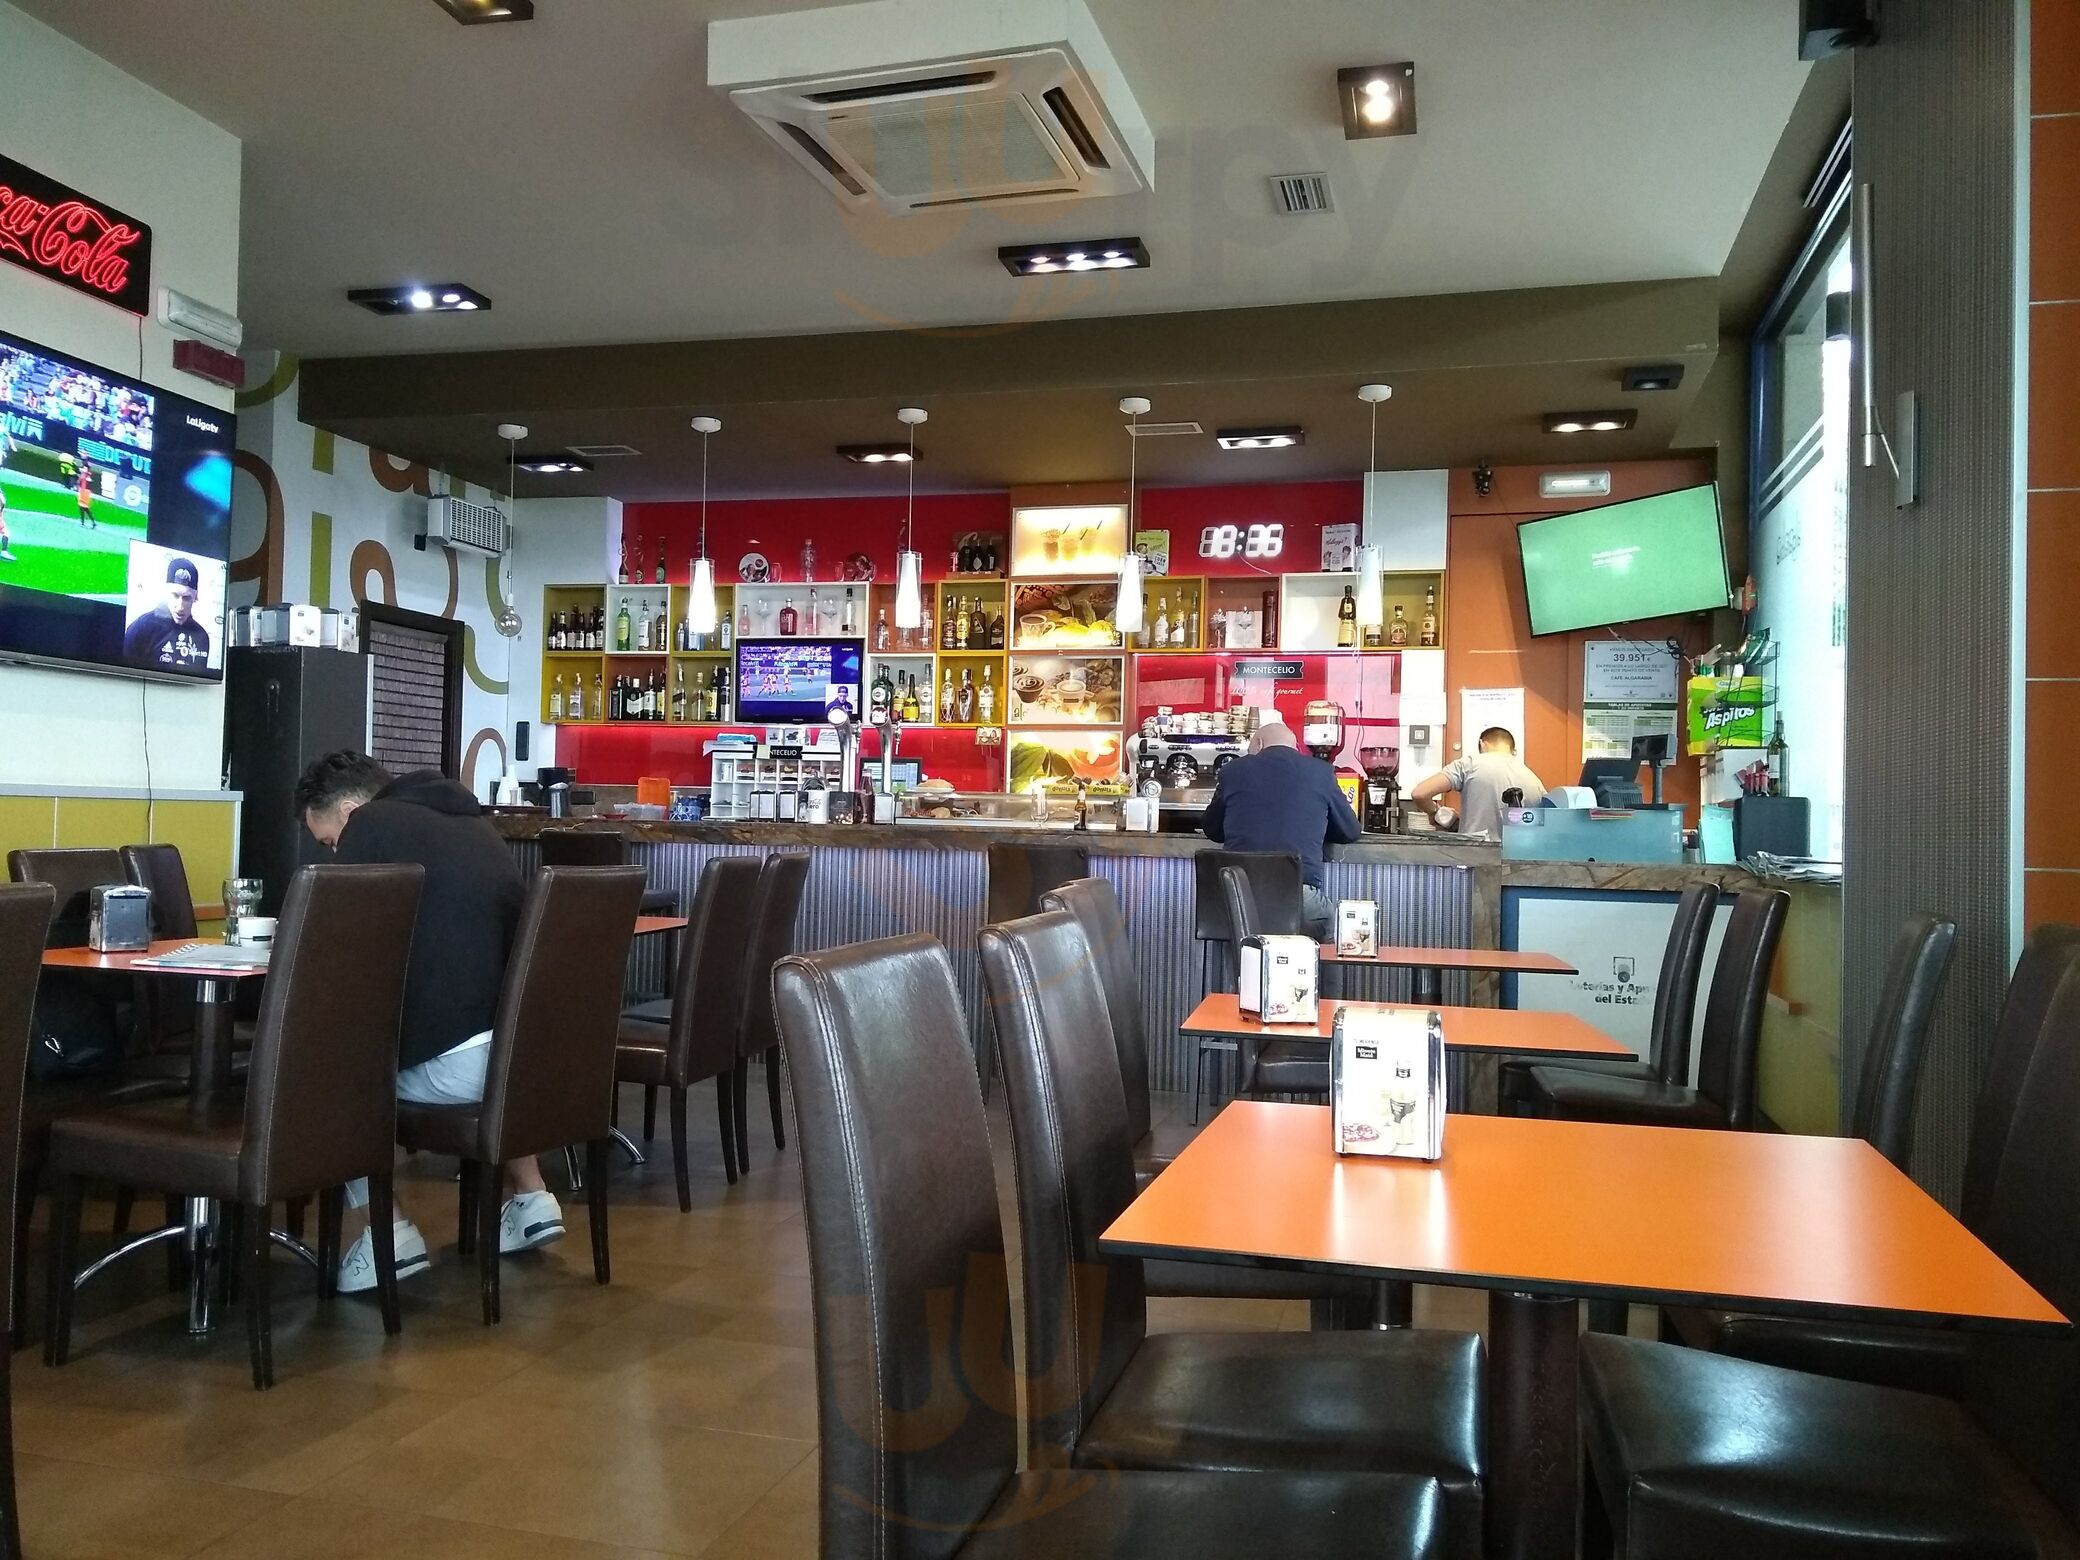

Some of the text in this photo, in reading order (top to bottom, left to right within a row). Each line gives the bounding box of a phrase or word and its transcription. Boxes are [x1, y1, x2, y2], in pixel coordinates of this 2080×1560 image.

[1199, 523, 1285, 558] 18:36
[1242, 666, 1296, 674] MONTECELIO
[1704, 705, 1756, 731] Aspitos
[1618, 984, 1624, 994] y
